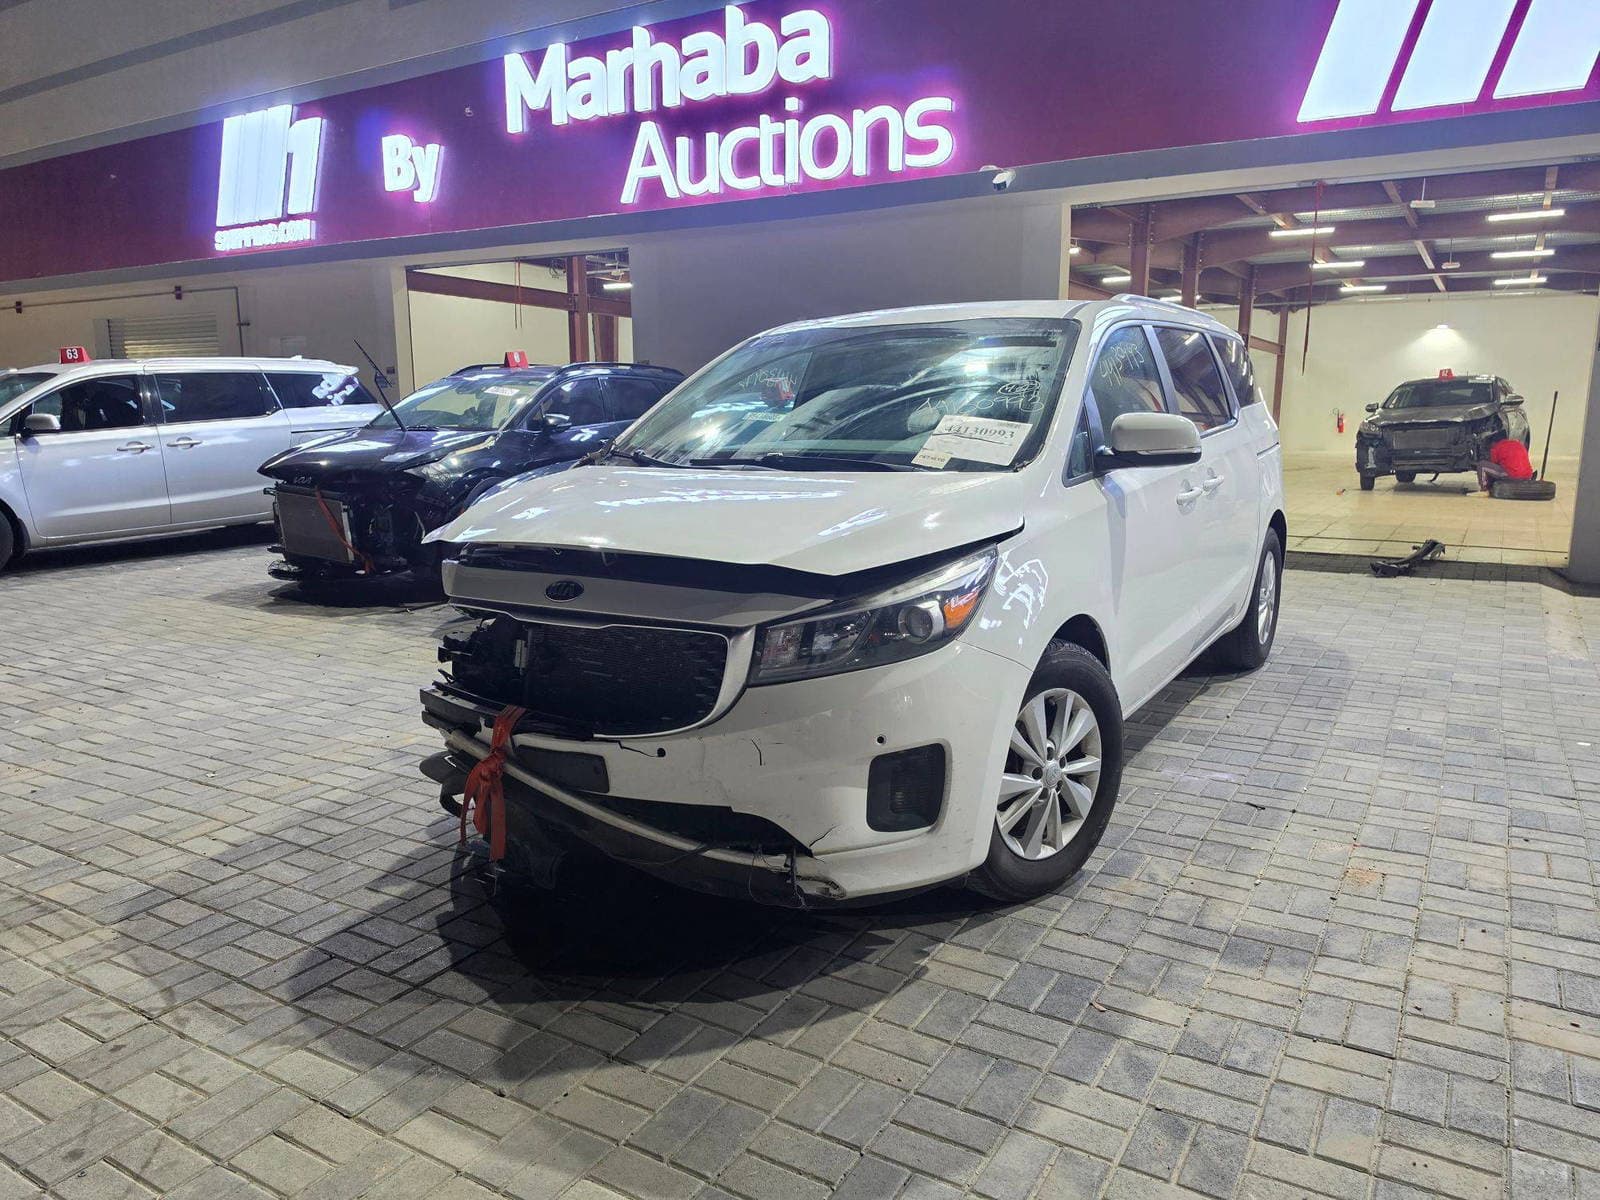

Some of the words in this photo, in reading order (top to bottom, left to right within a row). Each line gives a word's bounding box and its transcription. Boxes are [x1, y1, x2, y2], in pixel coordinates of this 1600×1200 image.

[503, 4, 832, 134] Marhaba
[381, 133, 441, 204] By
[620, 96, 955, 205] Auctions
[66, 348, 79, 360] 63
[944, 424, 1016, 440] 44130993
